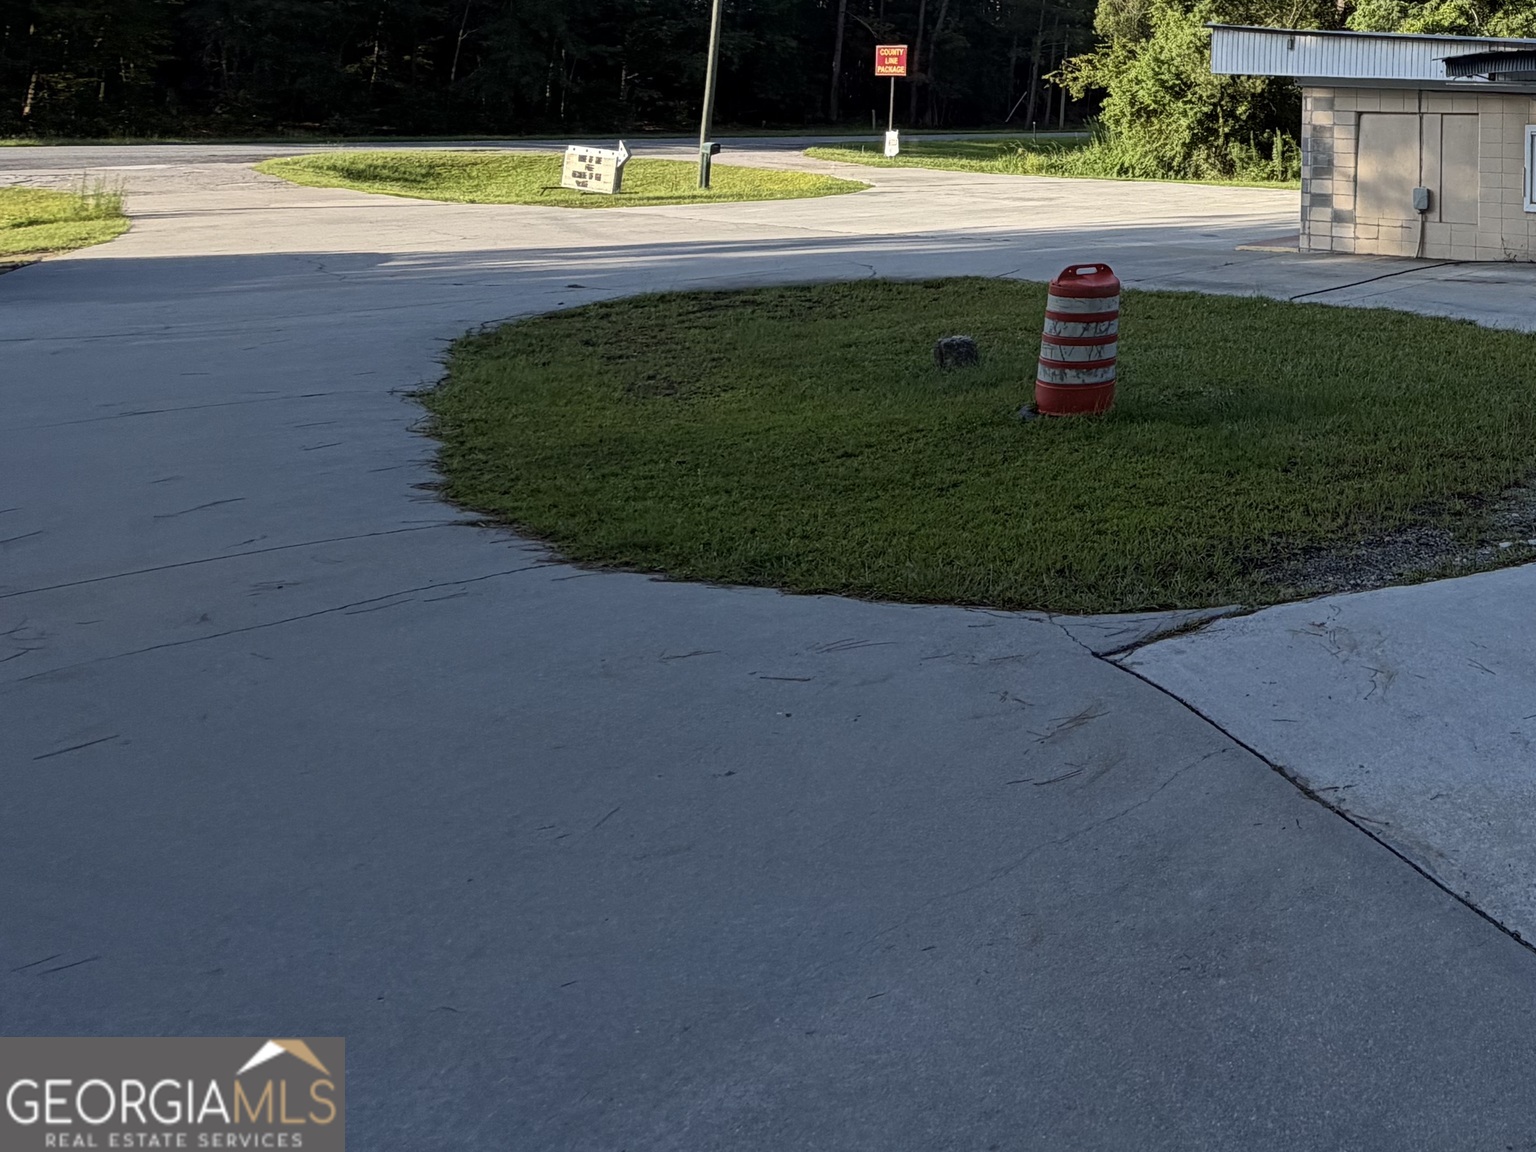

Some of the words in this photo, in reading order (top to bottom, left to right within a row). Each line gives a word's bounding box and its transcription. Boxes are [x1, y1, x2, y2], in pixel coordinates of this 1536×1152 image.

[880, 48, 904, 56] COUNTY
[885, 57, 898, 65] LINE
[877, 65, 905, 73] PACKAGE
